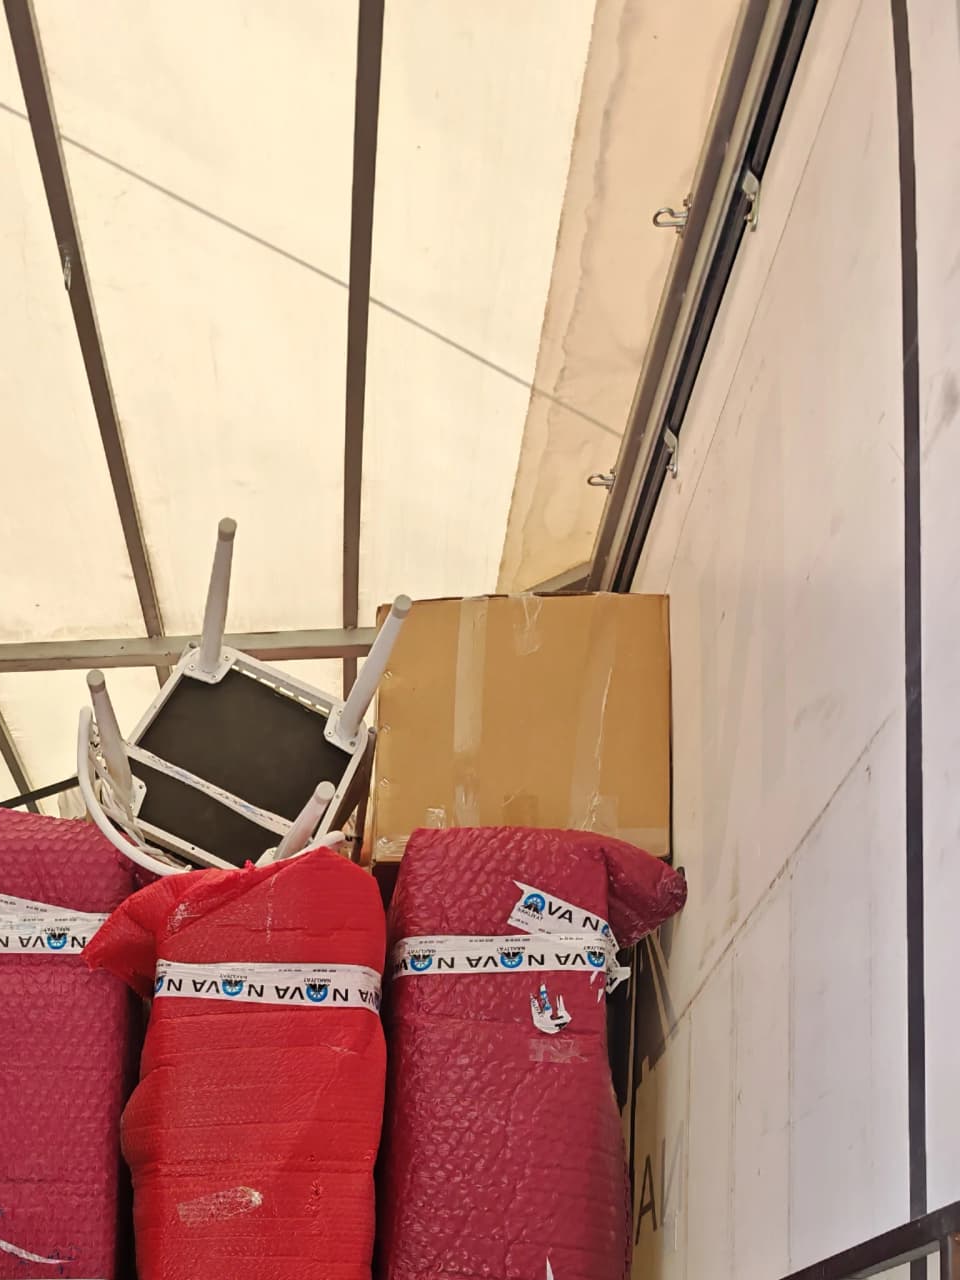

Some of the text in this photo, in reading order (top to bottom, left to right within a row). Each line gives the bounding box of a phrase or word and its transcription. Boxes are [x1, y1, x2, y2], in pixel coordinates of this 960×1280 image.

[17, 932, 87, 951] NOVA
[465, 952, 545, 971] NOVA
[555, 950, 606, 969] OVA
[191, 979, 265, 998] NOVA
[273, 983, 349, 1003] NOVA
